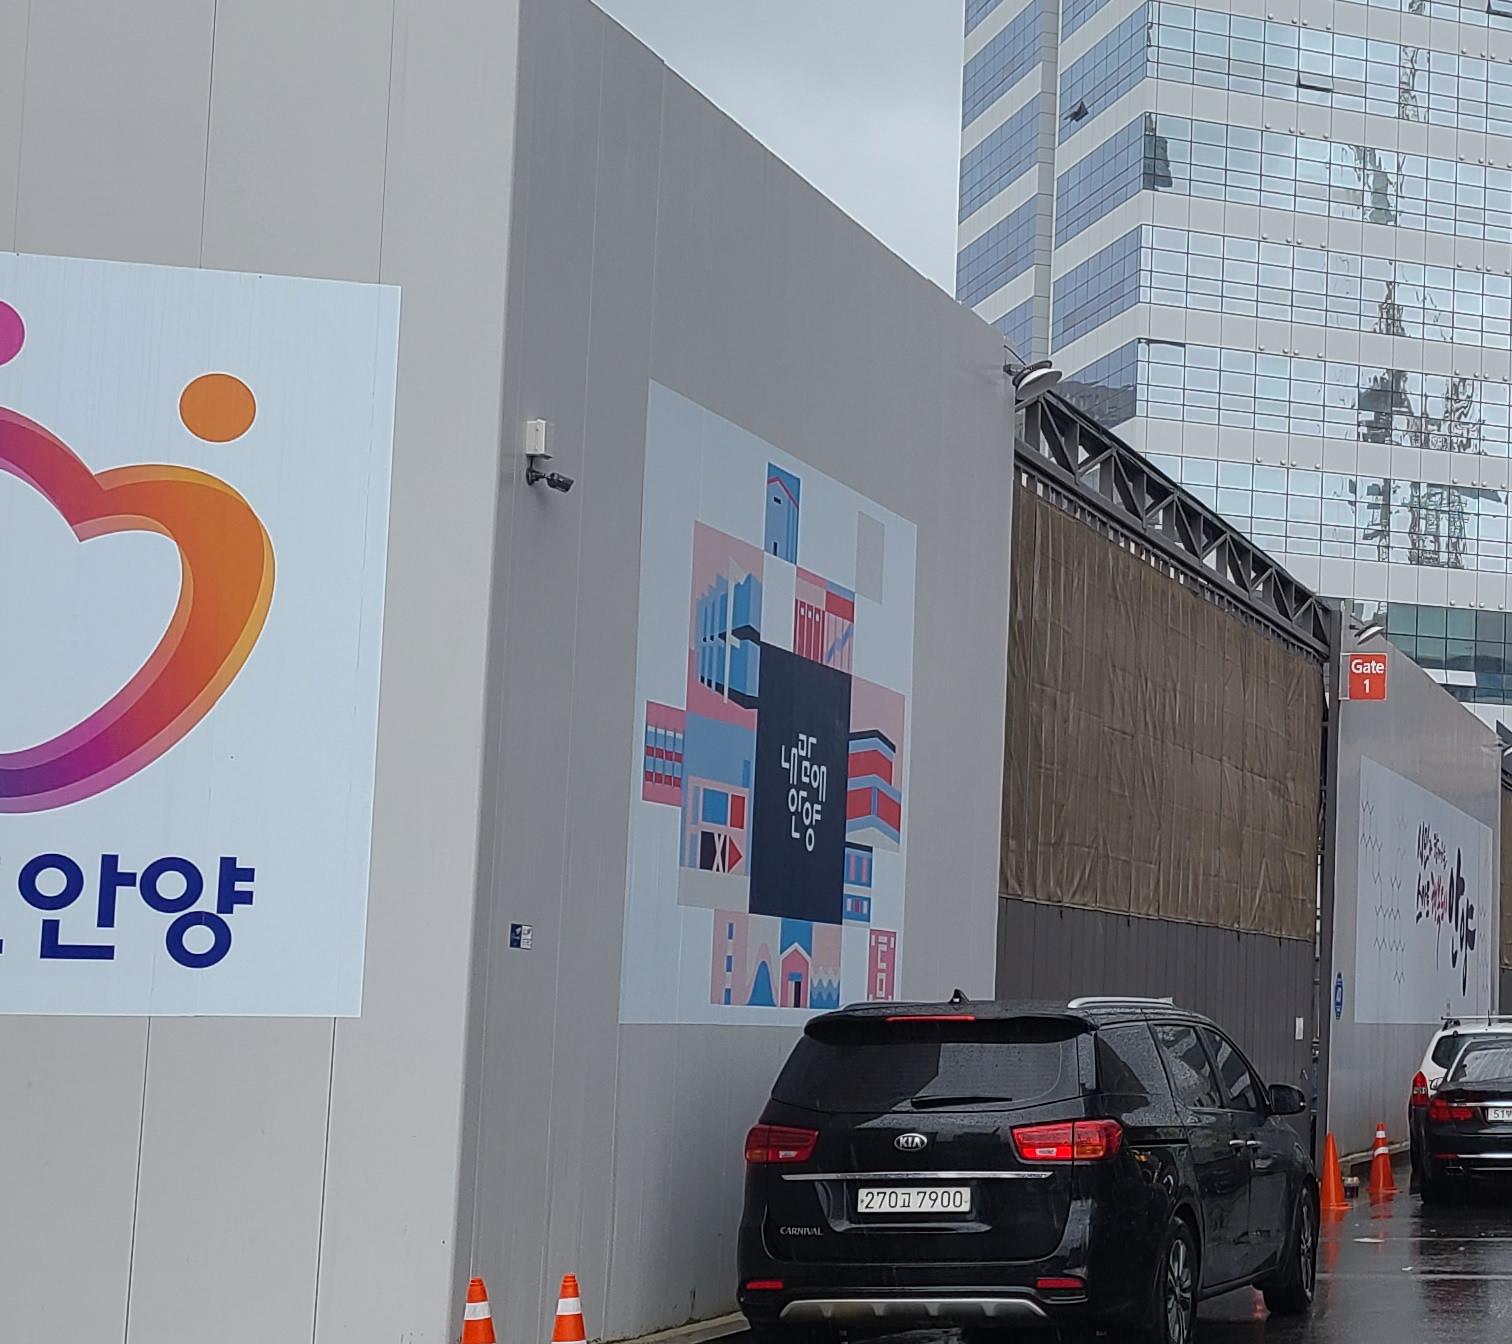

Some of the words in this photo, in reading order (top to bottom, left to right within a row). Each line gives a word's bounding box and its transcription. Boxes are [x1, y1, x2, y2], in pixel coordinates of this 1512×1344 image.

[1350, 658, 1385, 675] Gate
[1363, 679, 1371, 694] 1
[17, 853, 256, 970] 안양
[1448, 847, 1476, 997] 안양
[899, 1135, 922, 1149] KIA
[916, 1190, 963, 1209] 7900
[779, 1226, 824, 1236] CARNIVAL
